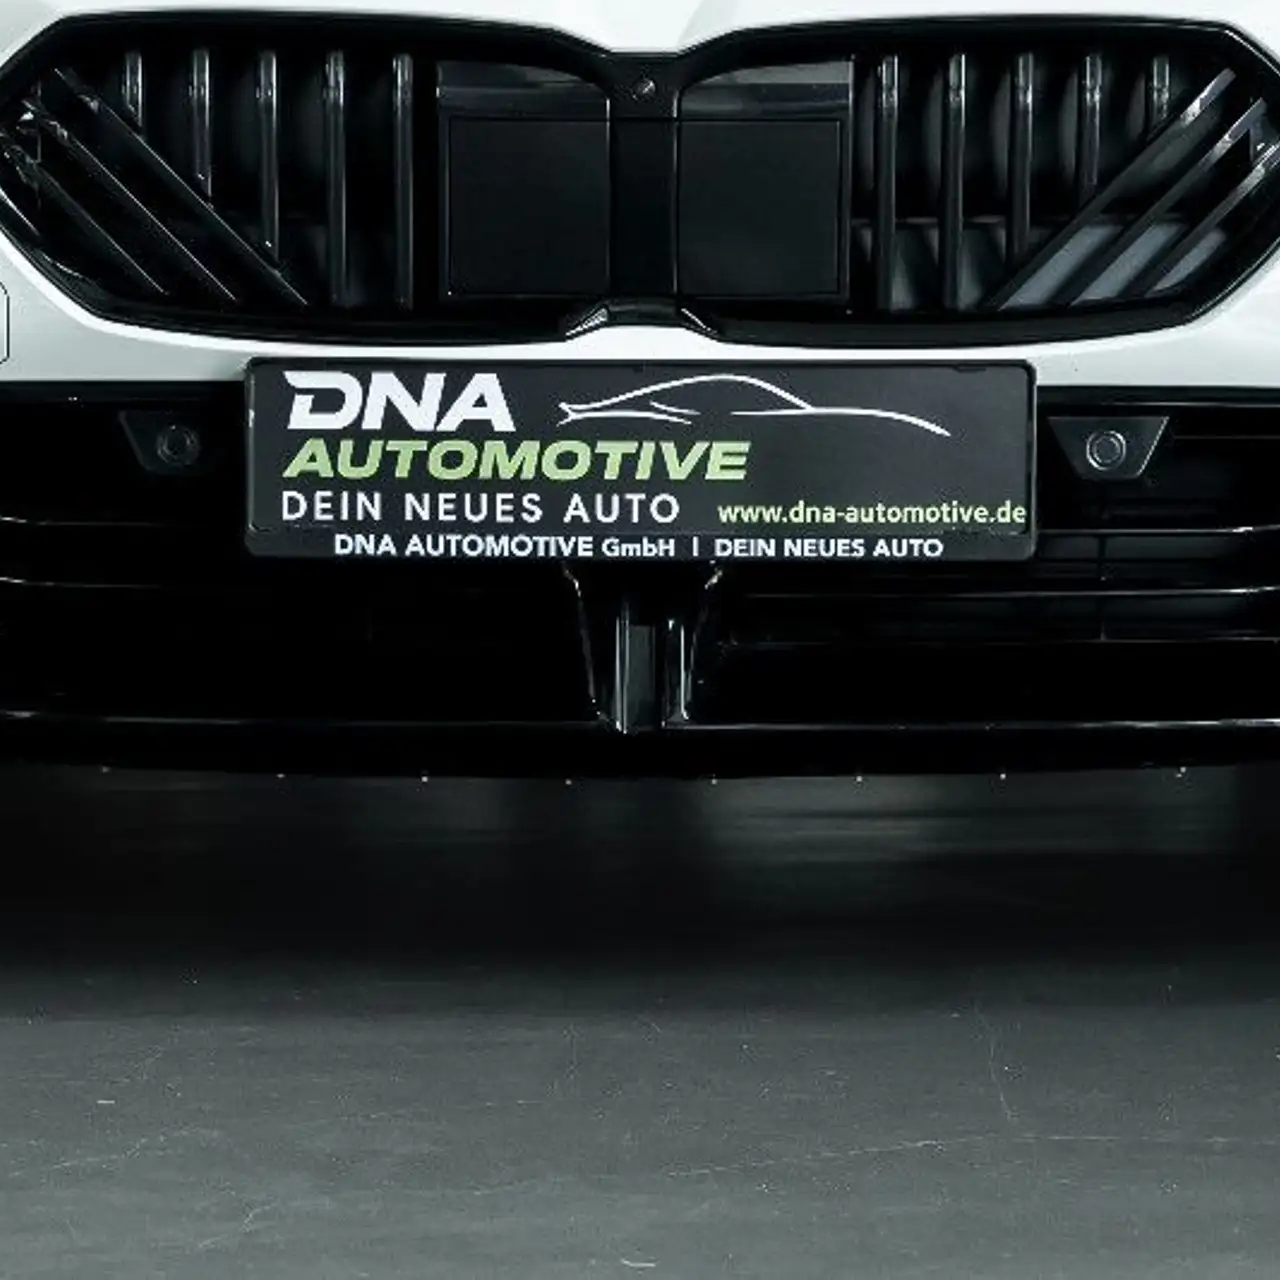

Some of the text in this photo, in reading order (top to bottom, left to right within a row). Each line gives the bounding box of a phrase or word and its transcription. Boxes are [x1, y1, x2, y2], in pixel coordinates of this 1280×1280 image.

[283, 371, 516, 432] DNA
[282, 438, 752, 480] AUTOMOTIVE
[282, 491, 680, 524] DEIN NEUES AUTO
[718, 500, 1027, 524] www.dna-automotive.de
[334, 533, 397, 555] DNA
[404, 533, 594, 558] AUTOMOTIVE
[601, 536, 675, 558] GmbH
[714, 538, 776, 558] DEIN
[783, 538, 865, 558] NEUES
[872, 538, 944, 558] AUTO
